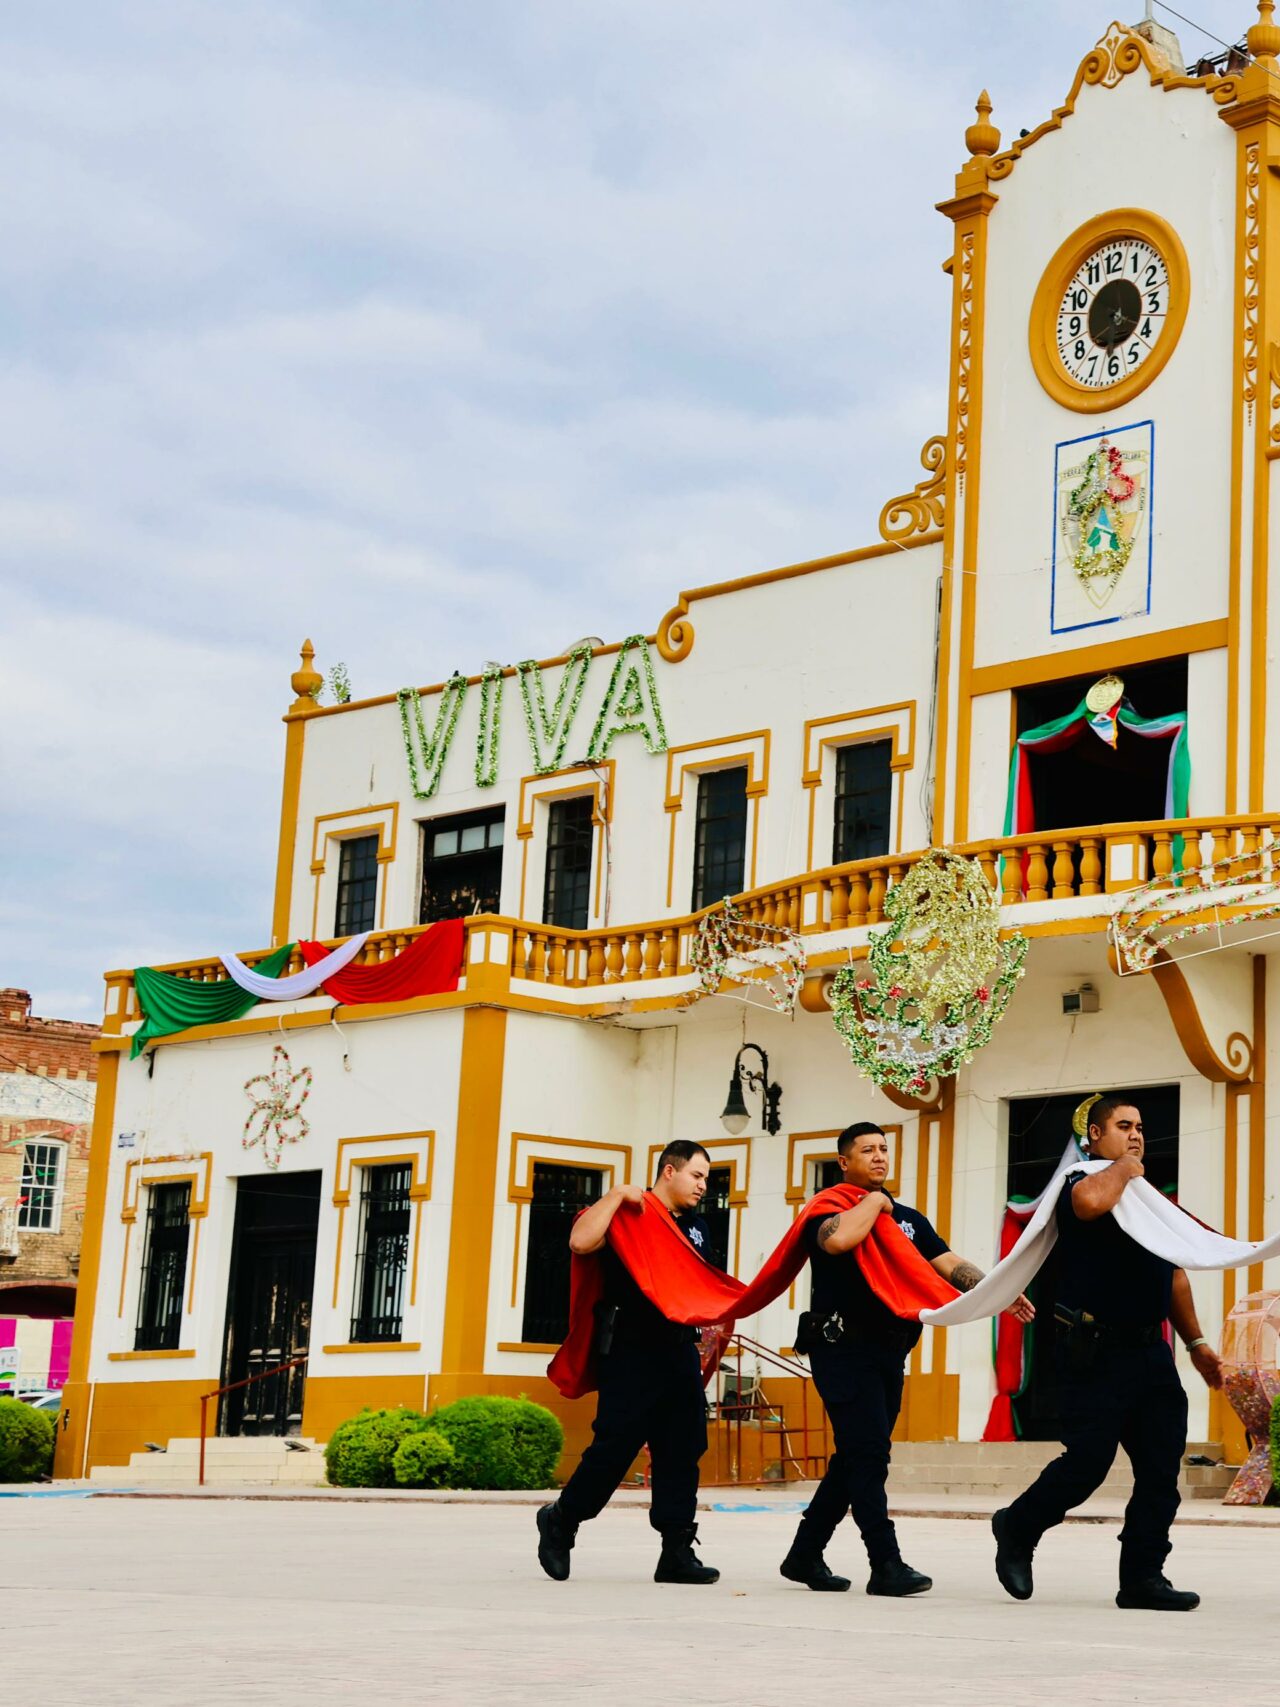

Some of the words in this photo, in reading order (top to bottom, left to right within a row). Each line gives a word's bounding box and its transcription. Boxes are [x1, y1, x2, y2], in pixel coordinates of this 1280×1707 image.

[1086, 262, 1099, 284] 11
[1105, 252, 1122, 274] 12
[1131, 252, 1138, 273] 1
[1145, 265, 1157, 287] 2
[1068, 289, 1087, 311] 10
[1148, 291, 1159, 313] 3
[1070, 316, 1080, 336] 9
[1141, 318, 1152, 338] 4
[1075, 340, 1085, 360] 8
[1128, 342, 1139, 364] 5
[1088, 355, 1098, 378] 7
[1108, 356, 1119, 376] 6
[397, 634, 669, 800] VIVA
